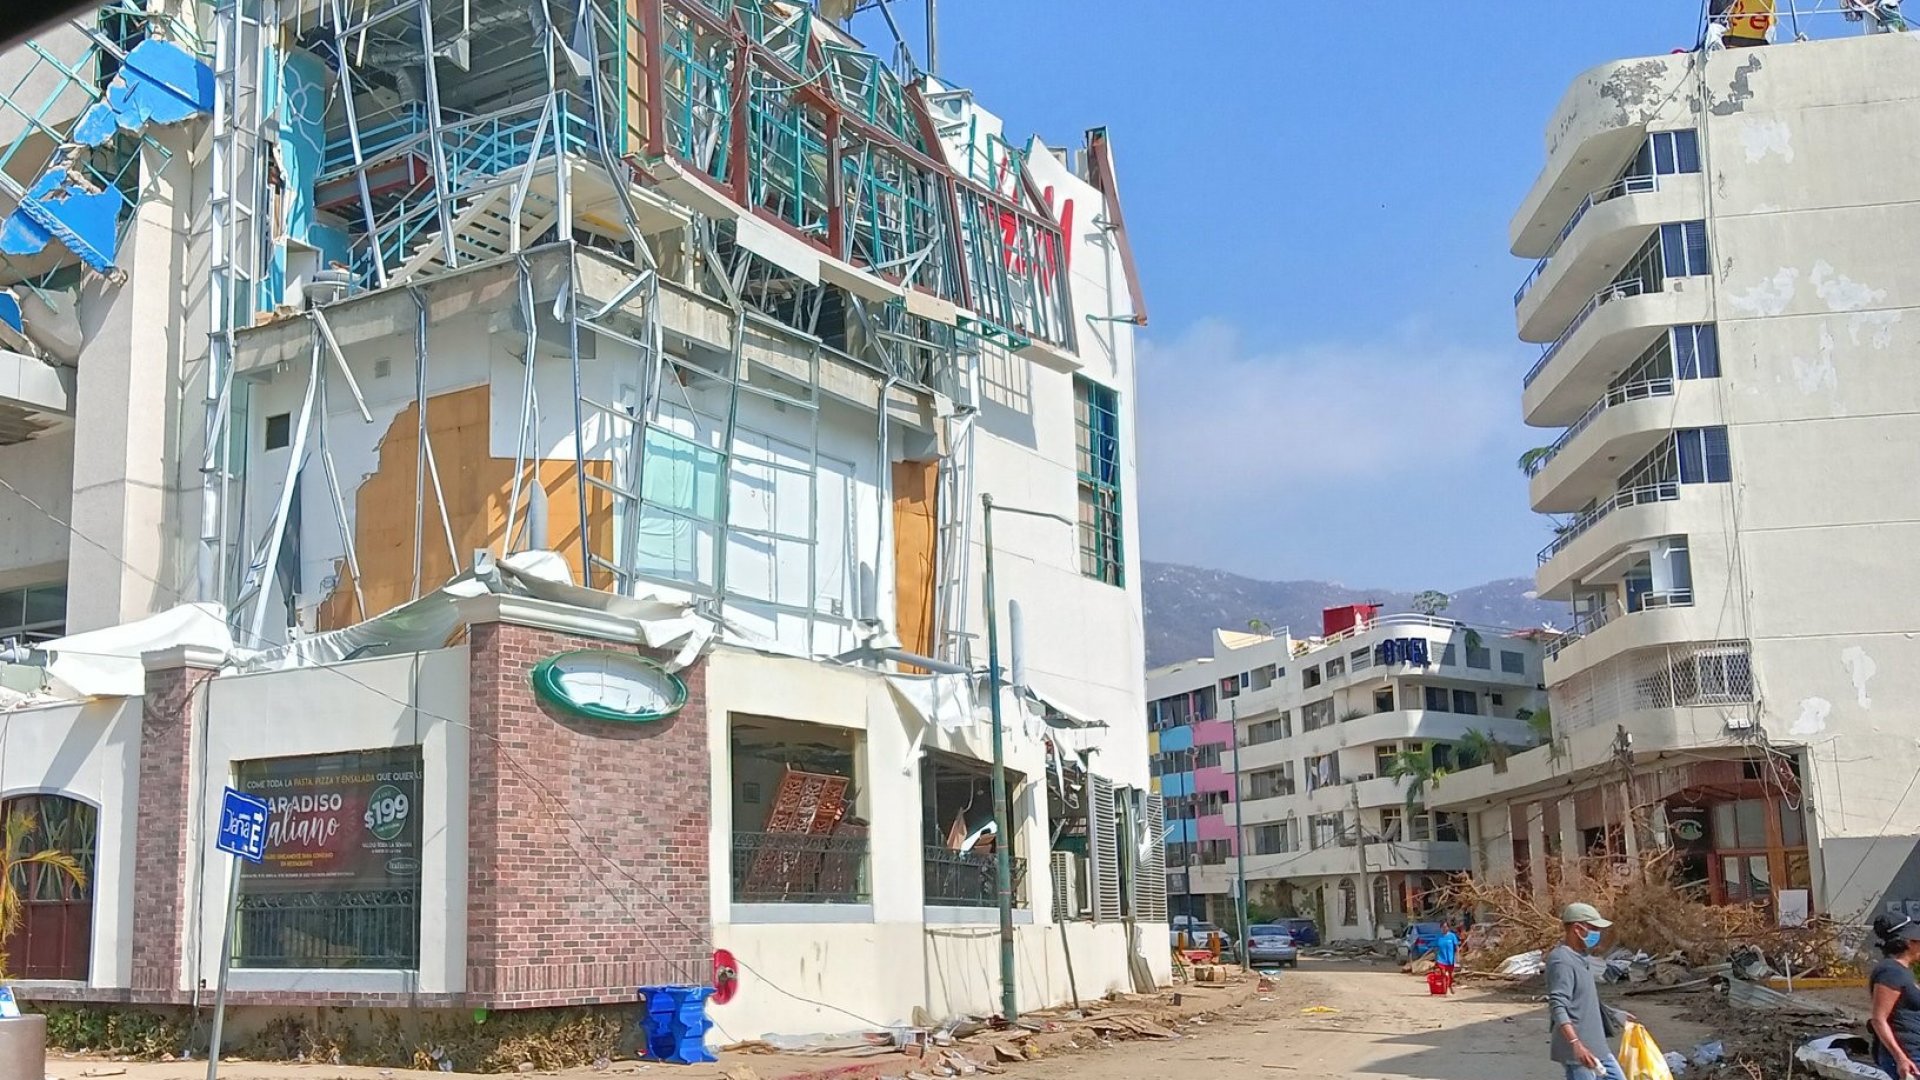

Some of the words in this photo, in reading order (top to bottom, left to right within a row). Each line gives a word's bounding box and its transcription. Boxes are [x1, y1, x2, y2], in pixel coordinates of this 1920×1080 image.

[266, 779, 283, 788] TODA
[284, 779, 293, 788] LA
[315, 776, 334, 786] PIZZA
[335, 775, 342, 784] Y
[342, 773, 375, 784] ENSALADA
[376, 772, 392, 781] QUE
[266, 793, 342, 813] ARADISO
[364, 794, 409, 830] $199
[249, 823, 261, 854] E
[263, 803, 340, 849] aliano
